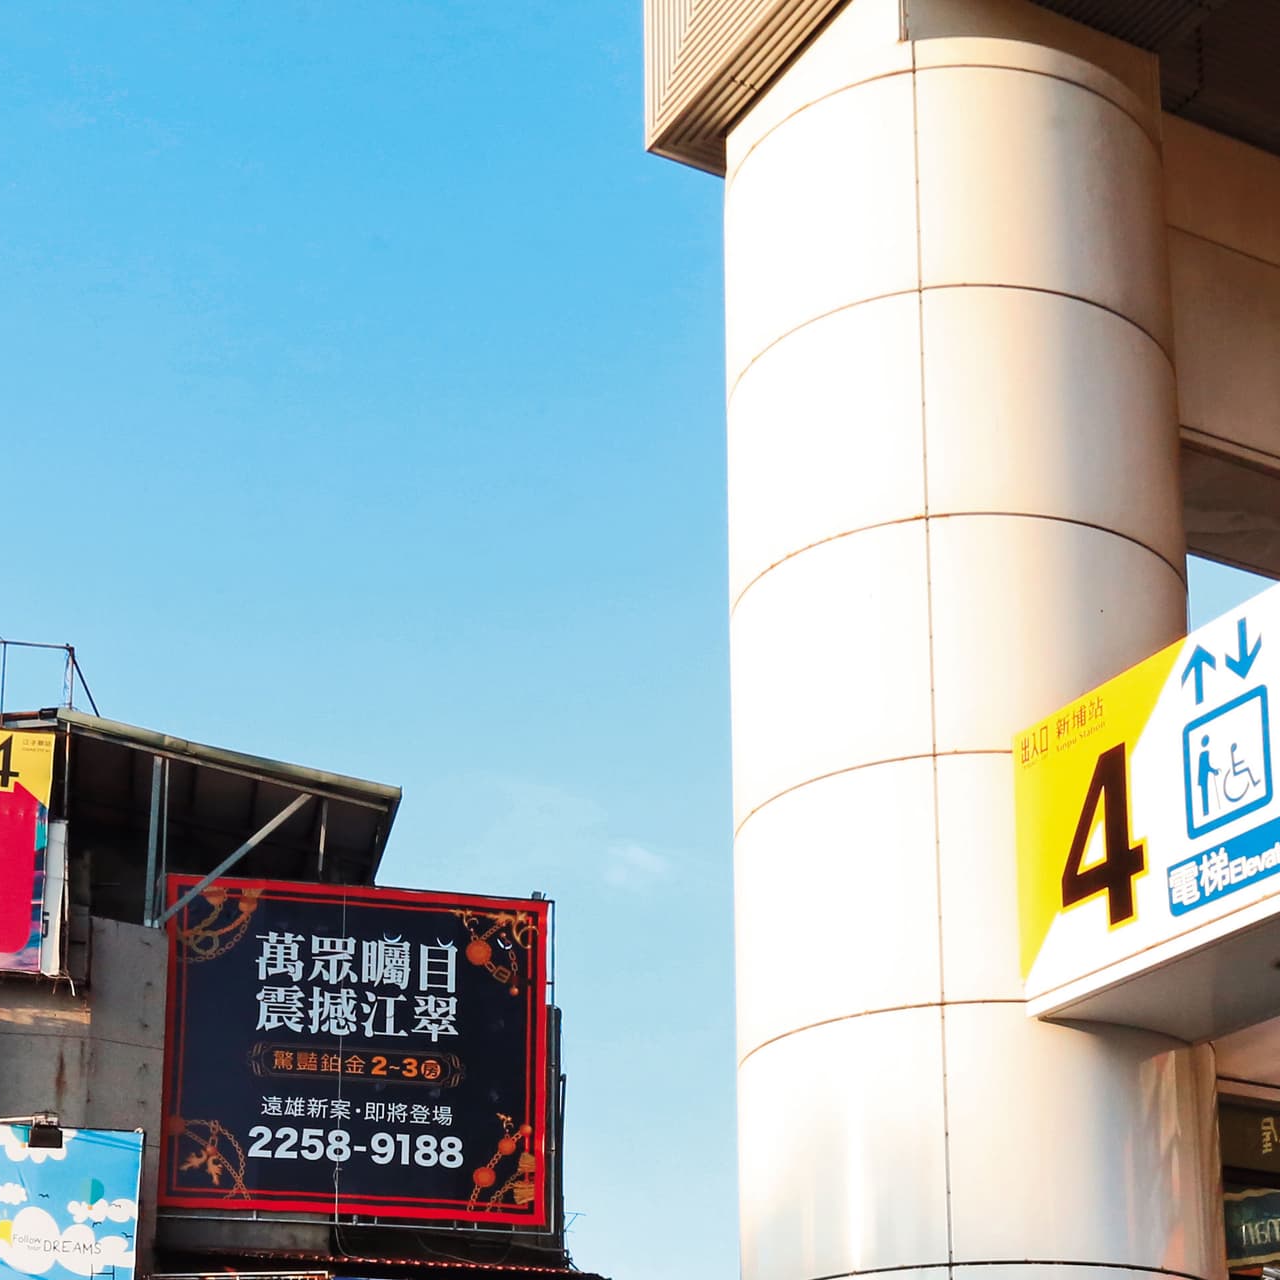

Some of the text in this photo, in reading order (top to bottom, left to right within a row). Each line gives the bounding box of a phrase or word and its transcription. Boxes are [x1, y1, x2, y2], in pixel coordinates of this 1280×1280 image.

[1021, 696, 1103, 764] 出入口 新埔站
[1061, 742, 1145, 927] 4
[1169, 847, 1230, 906] 電梯
[255, 931, 458, 994] 萬眾矚目
[255, 985, 460, 1042] 震撼江翠
[247, 1125, 464, 1169] 2258-9188
[13, 1233, 42, 1243] Follow
[43, 1239, 102, 1255] DREAMS
